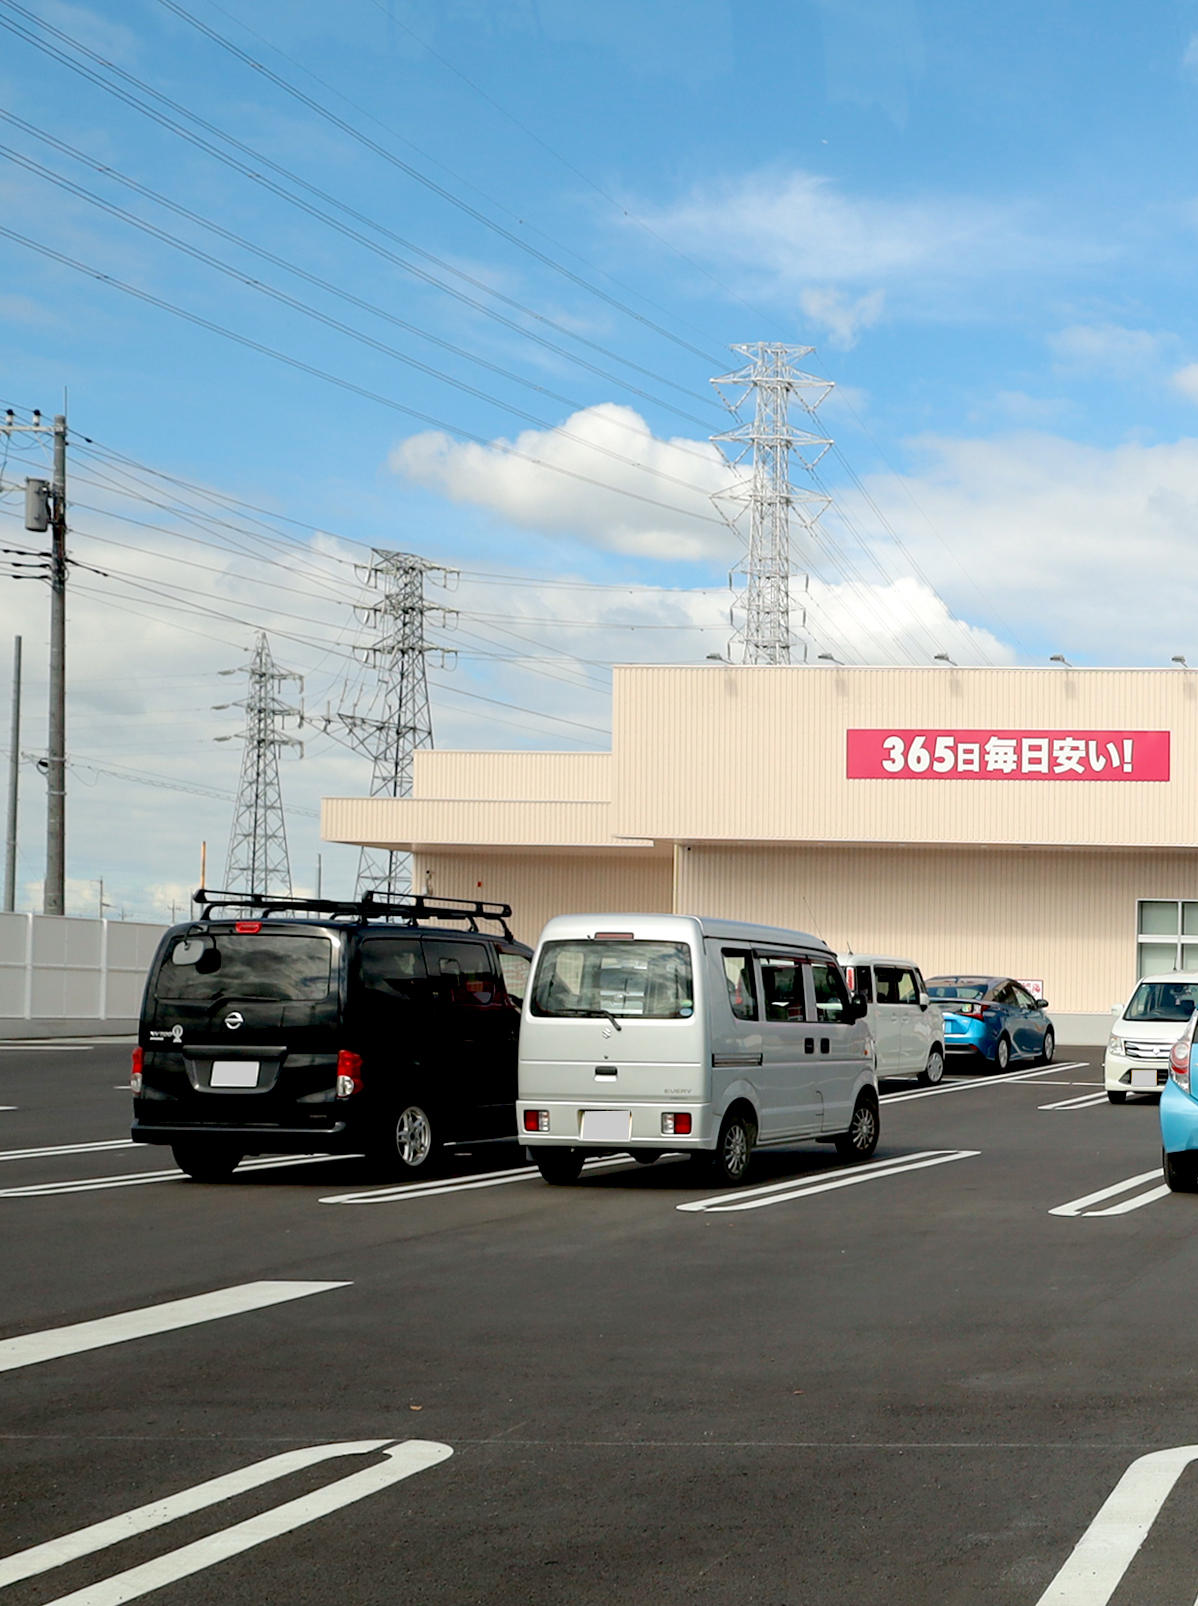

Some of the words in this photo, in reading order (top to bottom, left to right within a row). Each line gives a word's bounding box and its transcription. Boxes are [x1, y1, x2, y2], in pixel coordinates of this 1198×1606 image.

[881, 735, 1134, 774] 365日毎日安い!
